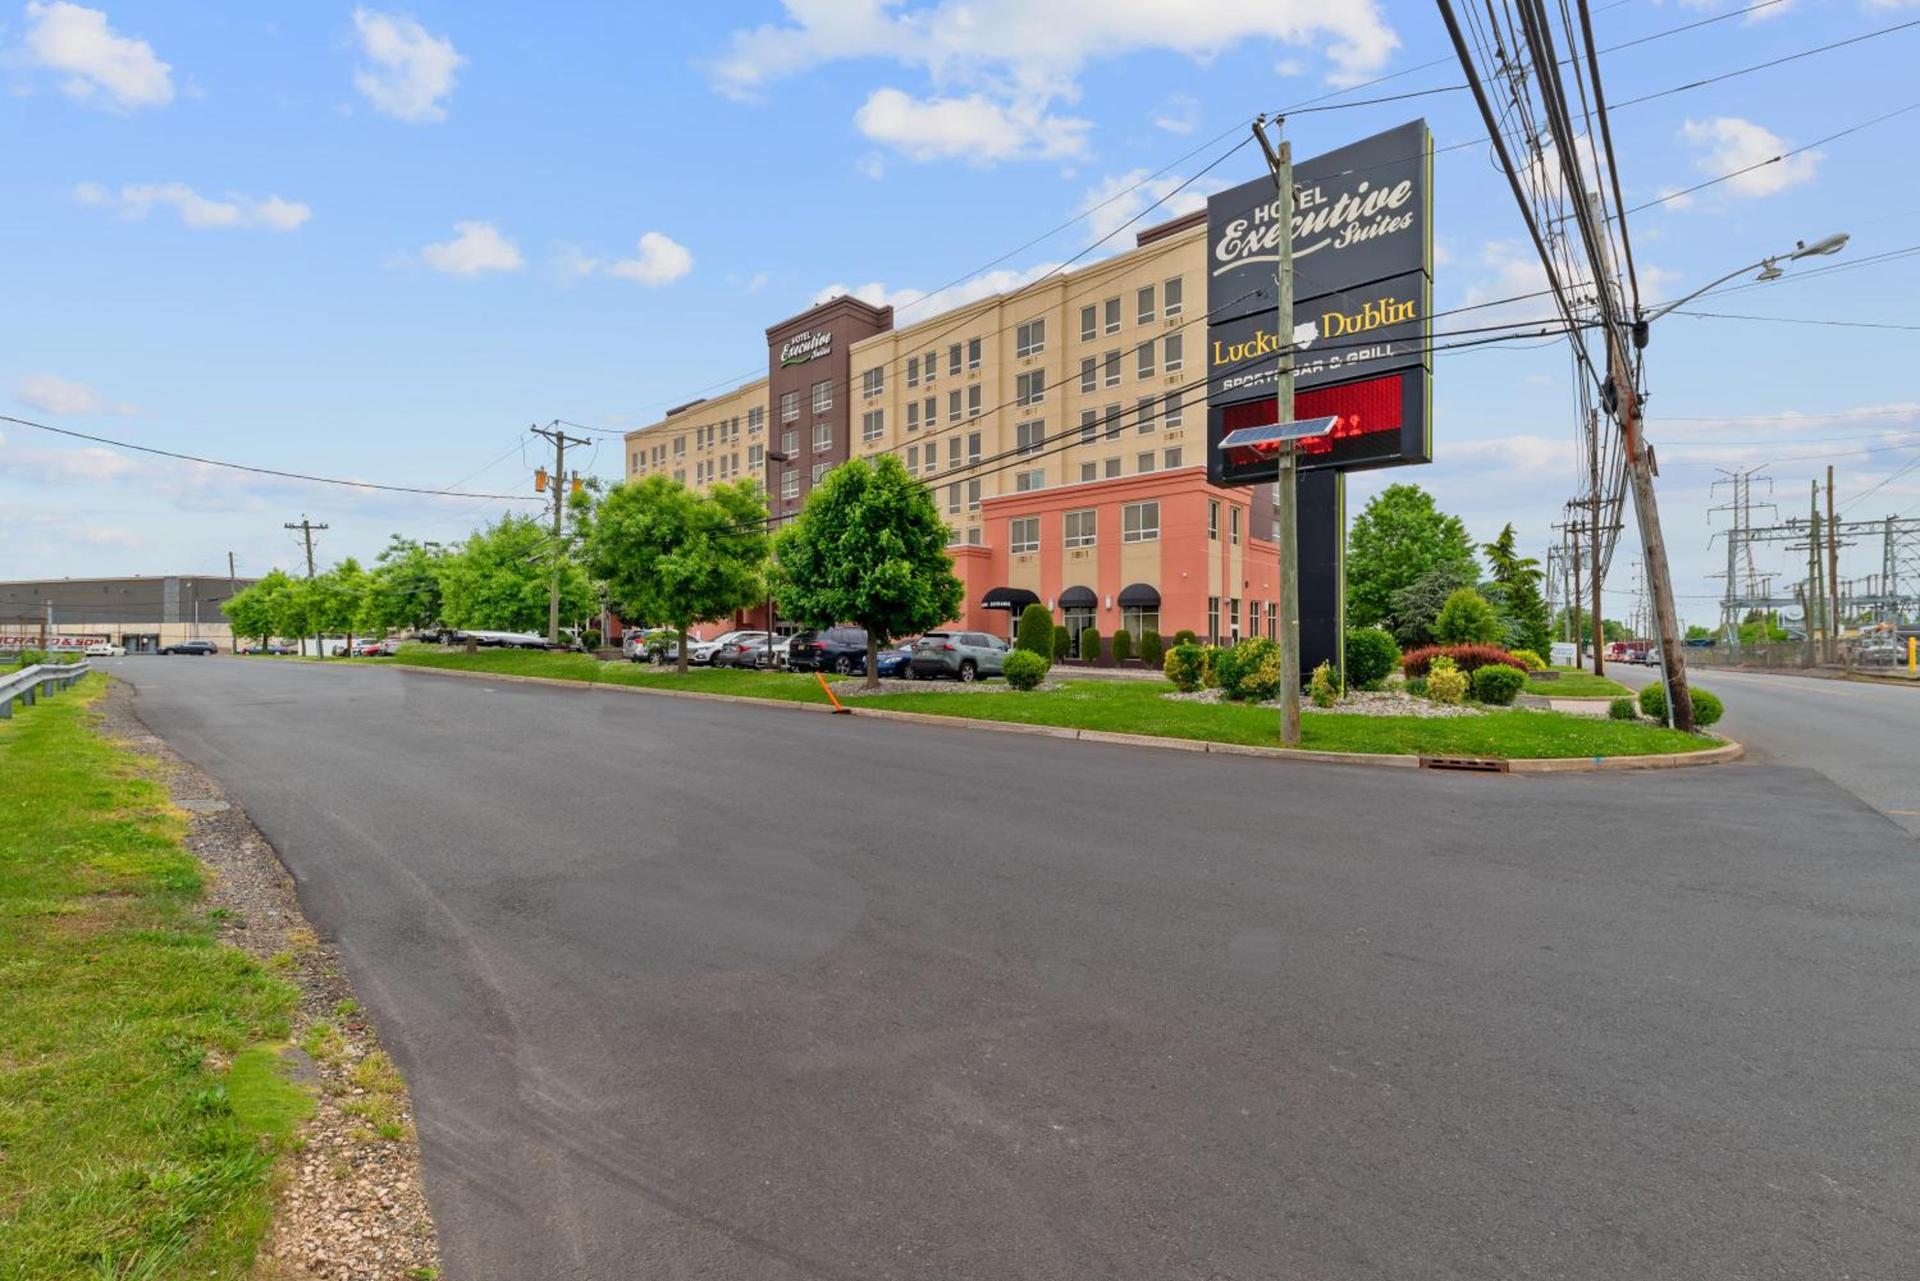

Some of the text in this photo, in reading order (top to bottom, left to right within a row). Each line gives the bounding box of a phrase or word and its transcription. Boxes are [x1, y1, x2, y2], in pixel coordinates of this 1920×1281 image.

[1254, 186, 1328, 225] HOEL
[1333, 211, 1414, 249] Suites
[1321, 297, 1416, 339] Dublin
[791, 330, 810, 345] HOTEL
[1346, 343, 1395, 366] GRILL
